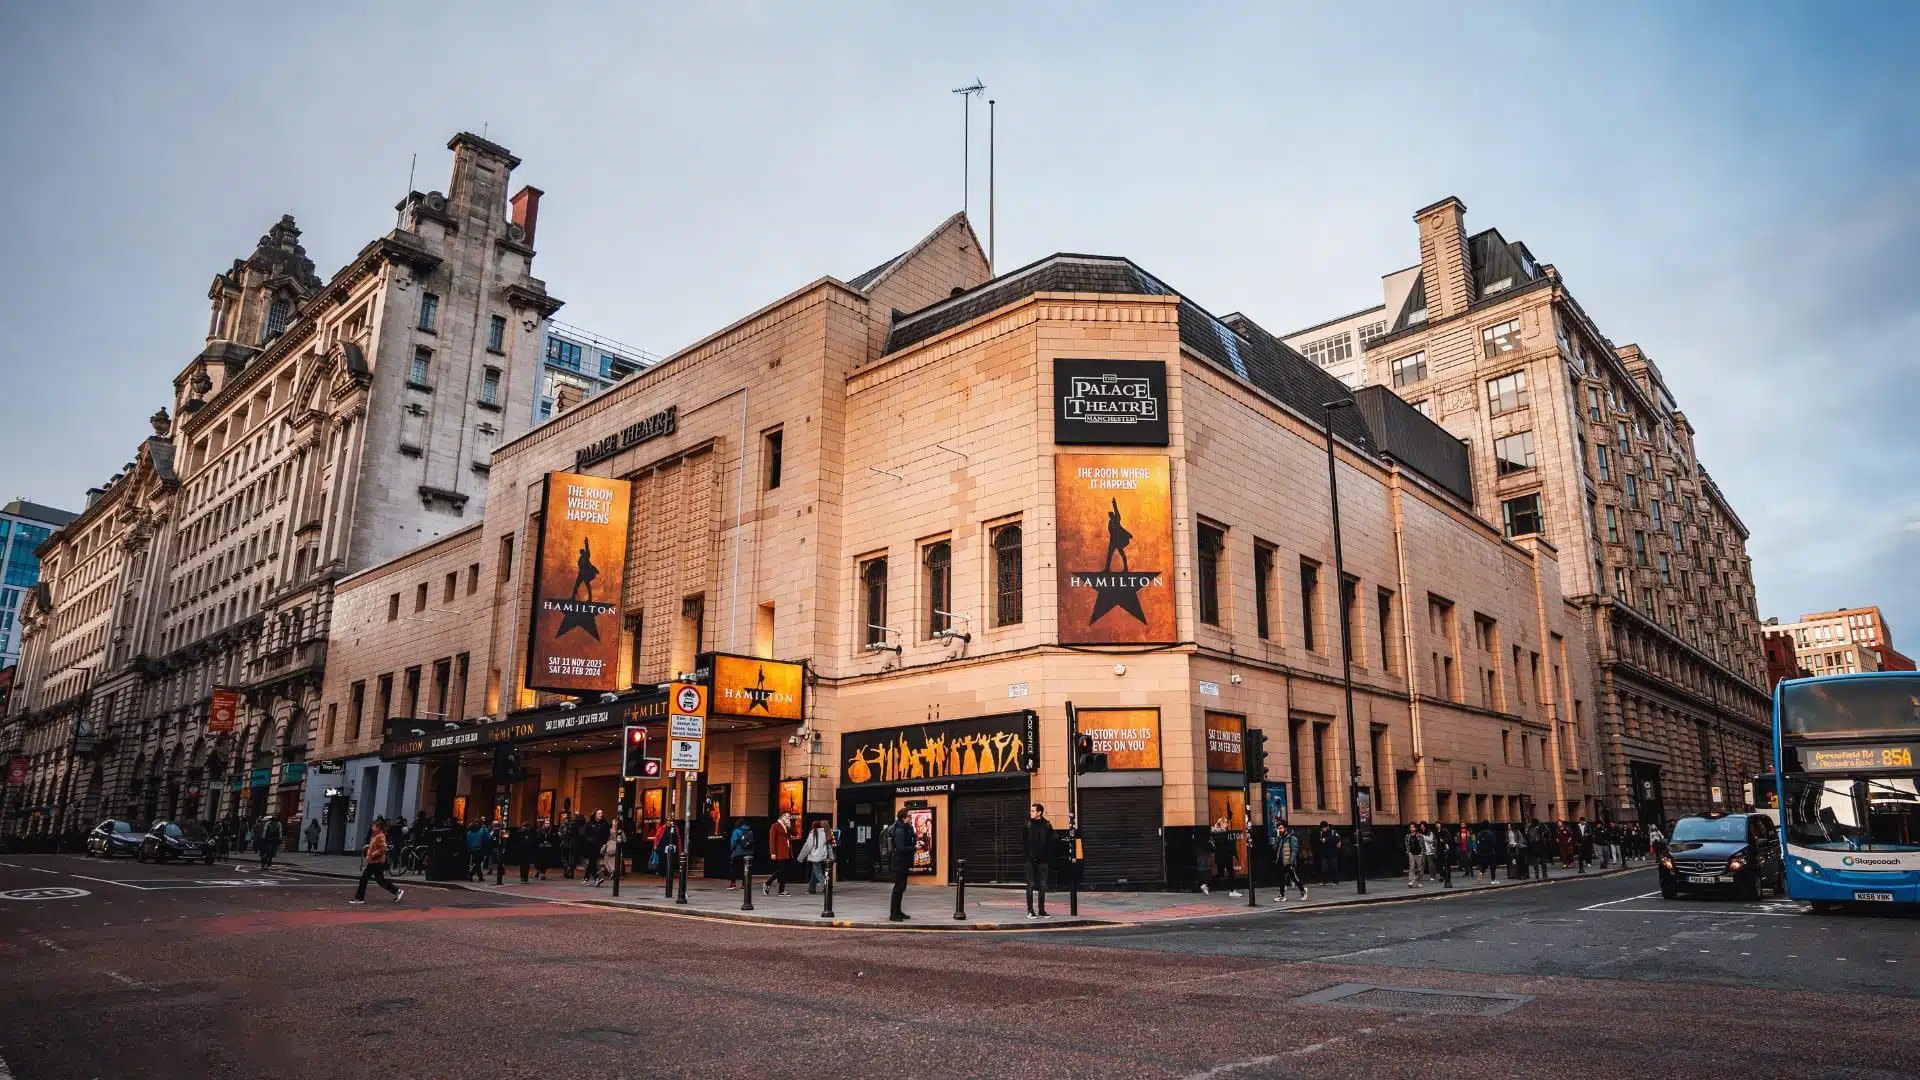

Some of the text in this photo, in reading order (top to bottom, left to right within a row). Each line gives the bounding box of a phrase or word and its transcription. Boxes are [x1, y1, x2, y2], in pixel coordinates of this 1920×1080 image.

[1075, 381, 1148, 398] PALACE
[1068, 399, 1154, 415] THEATRE
[575, 404, 677, 473] PALACE THEATRE
[1077, 467, 1150, 480] THE ROOM WHERE
[1090, 479, 1137, 490] IT HAPPENS
[567, 484, 613, 501] THE ROOM
[567, 497, 611, 513] WHERE IT
[567, 509, 609, 524] HAPPENS
[1070, 577, 1163, 587] HAMILTON
[543, 601, 617, 615] HAMILTON
[548, 656, 561, 665] SAT
[562, 657, 570, 666] 11
[571, 658, 585, 667] NOV
[548, 665, 601, 676] SAT 24 FEB 2024
[725, 688, 793, 703] HAMILTON
[1085, 727, 1151, 740] HISTORY HAS ITS
[1092, 740, 1145, 752] EYES ON YOU
[1882, 748, 1912, 766] 85A
[1855, 858, 1901, 866] Stagecoach
